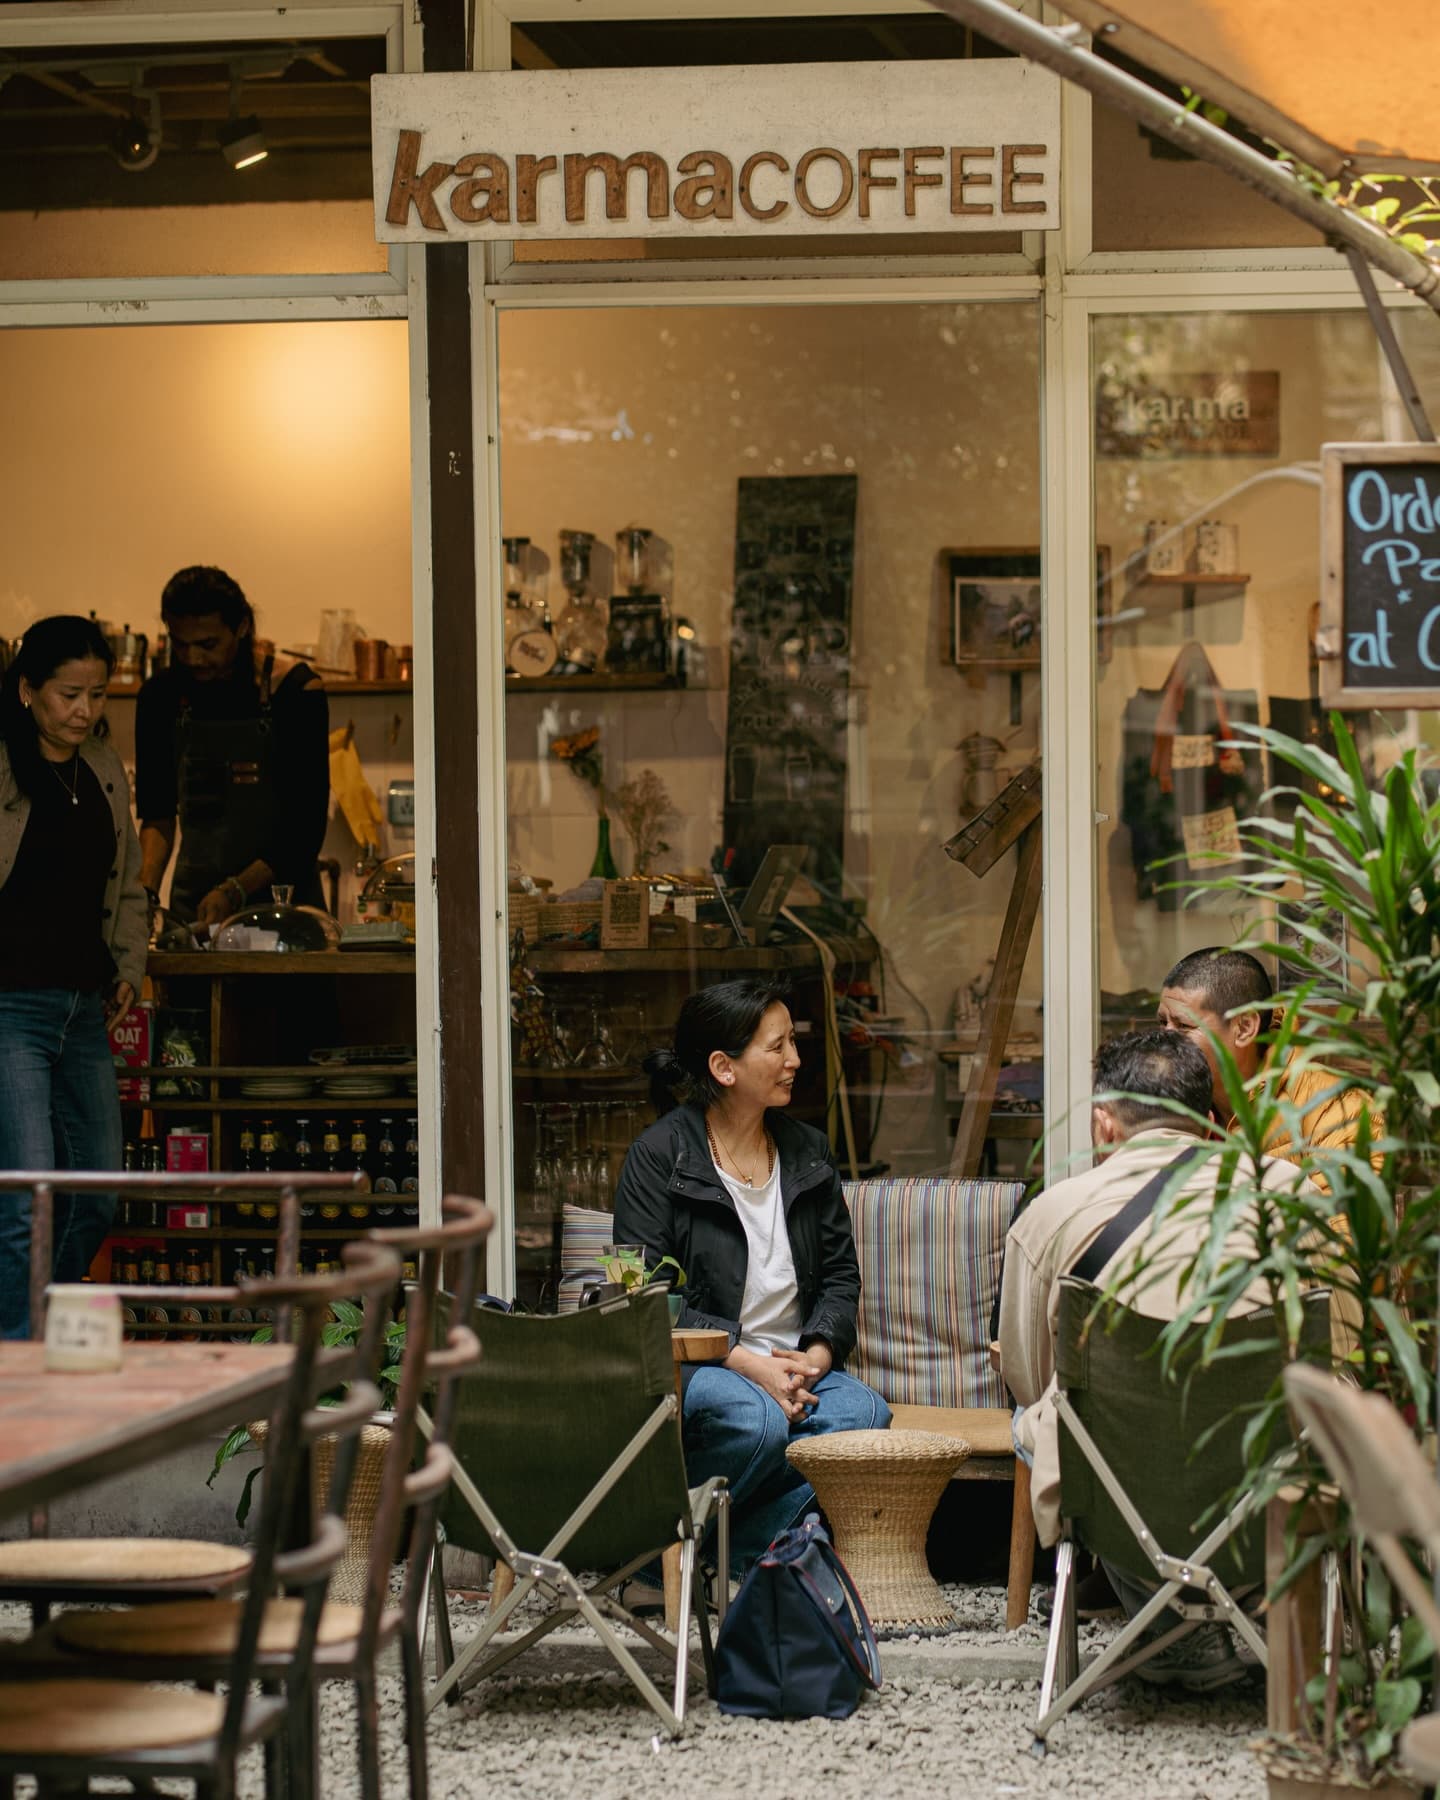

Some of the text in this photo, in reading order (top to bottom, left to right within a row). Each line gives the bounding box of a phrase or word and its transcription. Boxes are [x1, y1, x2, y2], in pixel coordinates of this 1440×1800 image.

[1348, 470, 1440, 534] Ord
[1348, 608, 1397, 669] at
[113, 1027, 143, 1045] OAT
